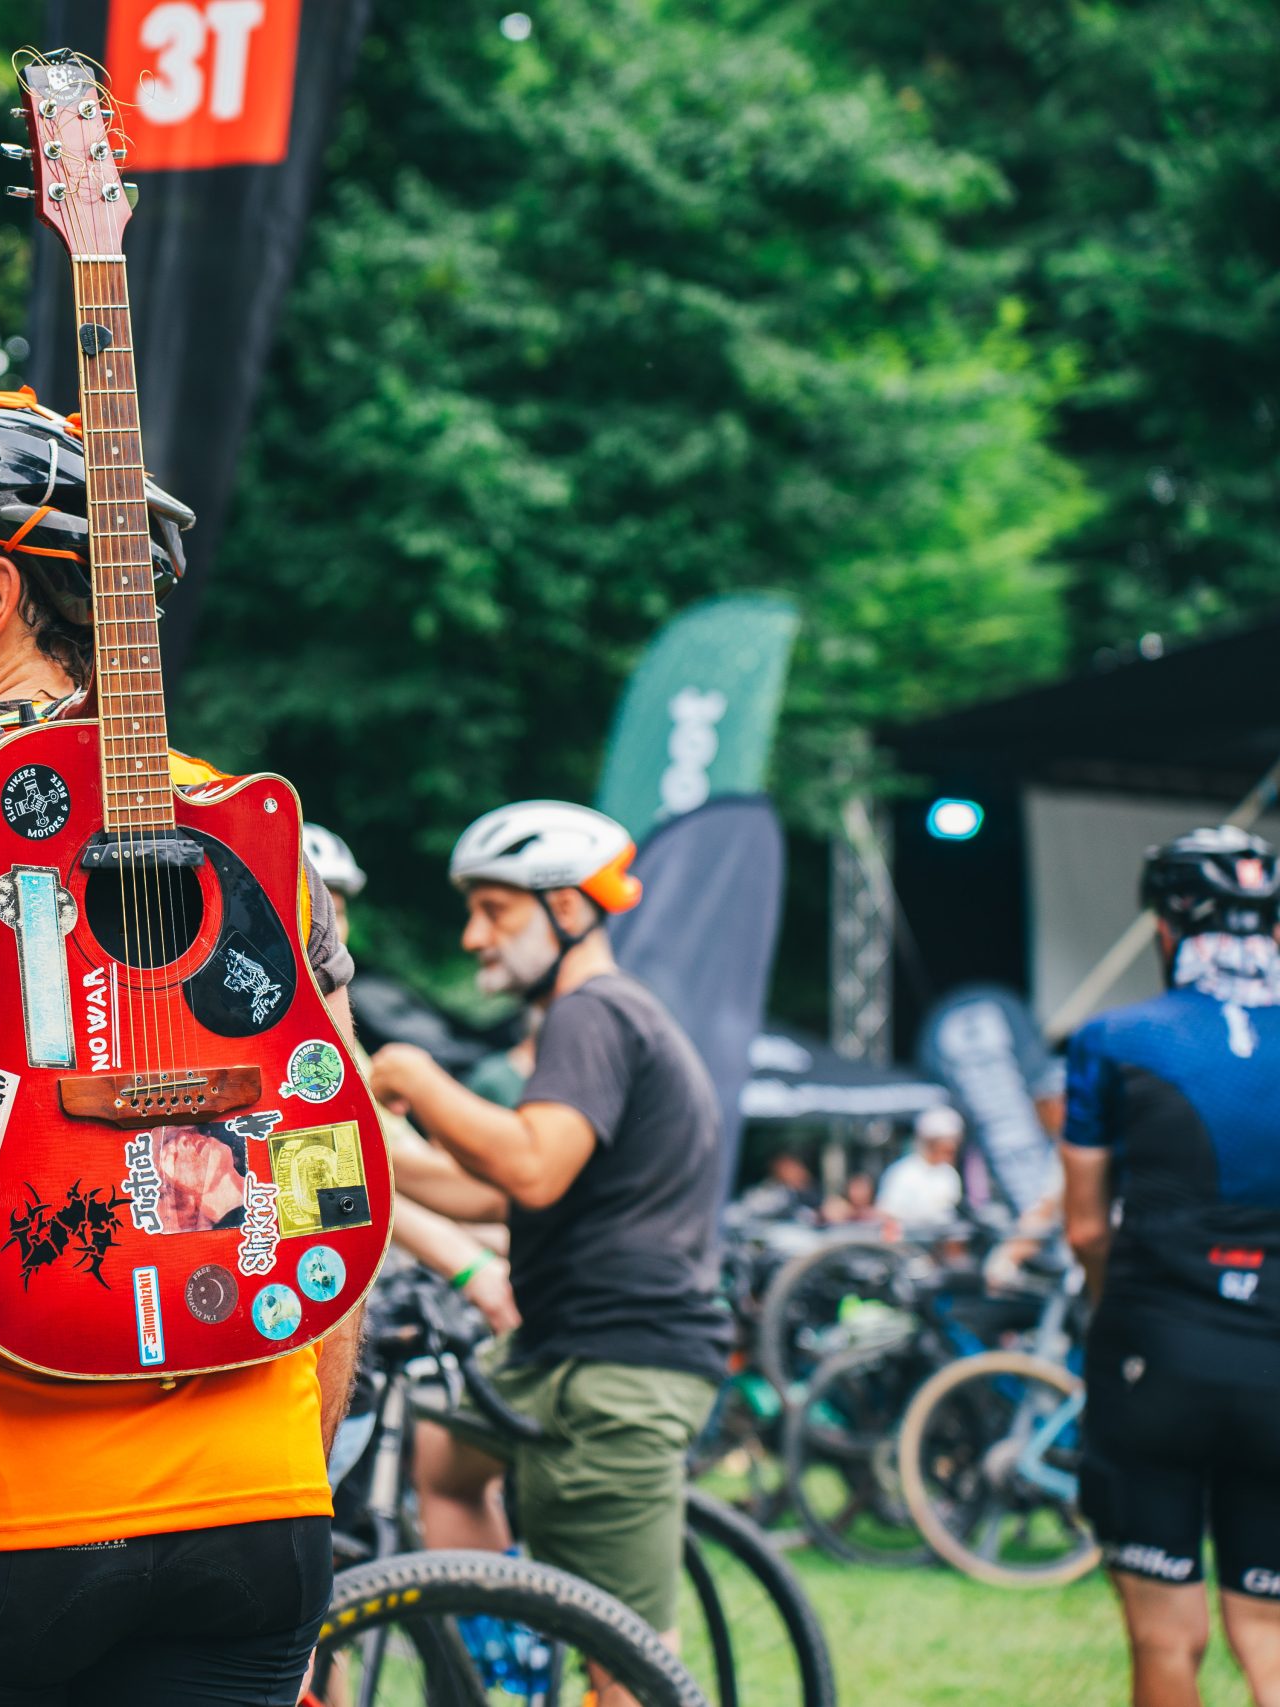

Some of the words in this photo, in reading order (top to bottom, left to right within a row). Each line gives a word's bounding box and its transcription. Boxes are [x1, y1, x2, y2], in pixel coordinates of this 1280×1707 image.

[135, 0, 266, 125] 3T
[6, 767, 36, 793] BIKERS
[4, 797, 17, 823] ELFO
[27, 815, 65, 838] MOTORS
[49, 773, 68, 799] BEER
[83, 967, 109, 1031] WAR
[92, 1038, 110, 1072] NO
[277, 1147, 294, 1193] MARKLEY
[281, 1195, 304, 1220] DEAN
[192, 1266, 211, 1281] FREE
[186, 1282, 203, 1317] DOPING
